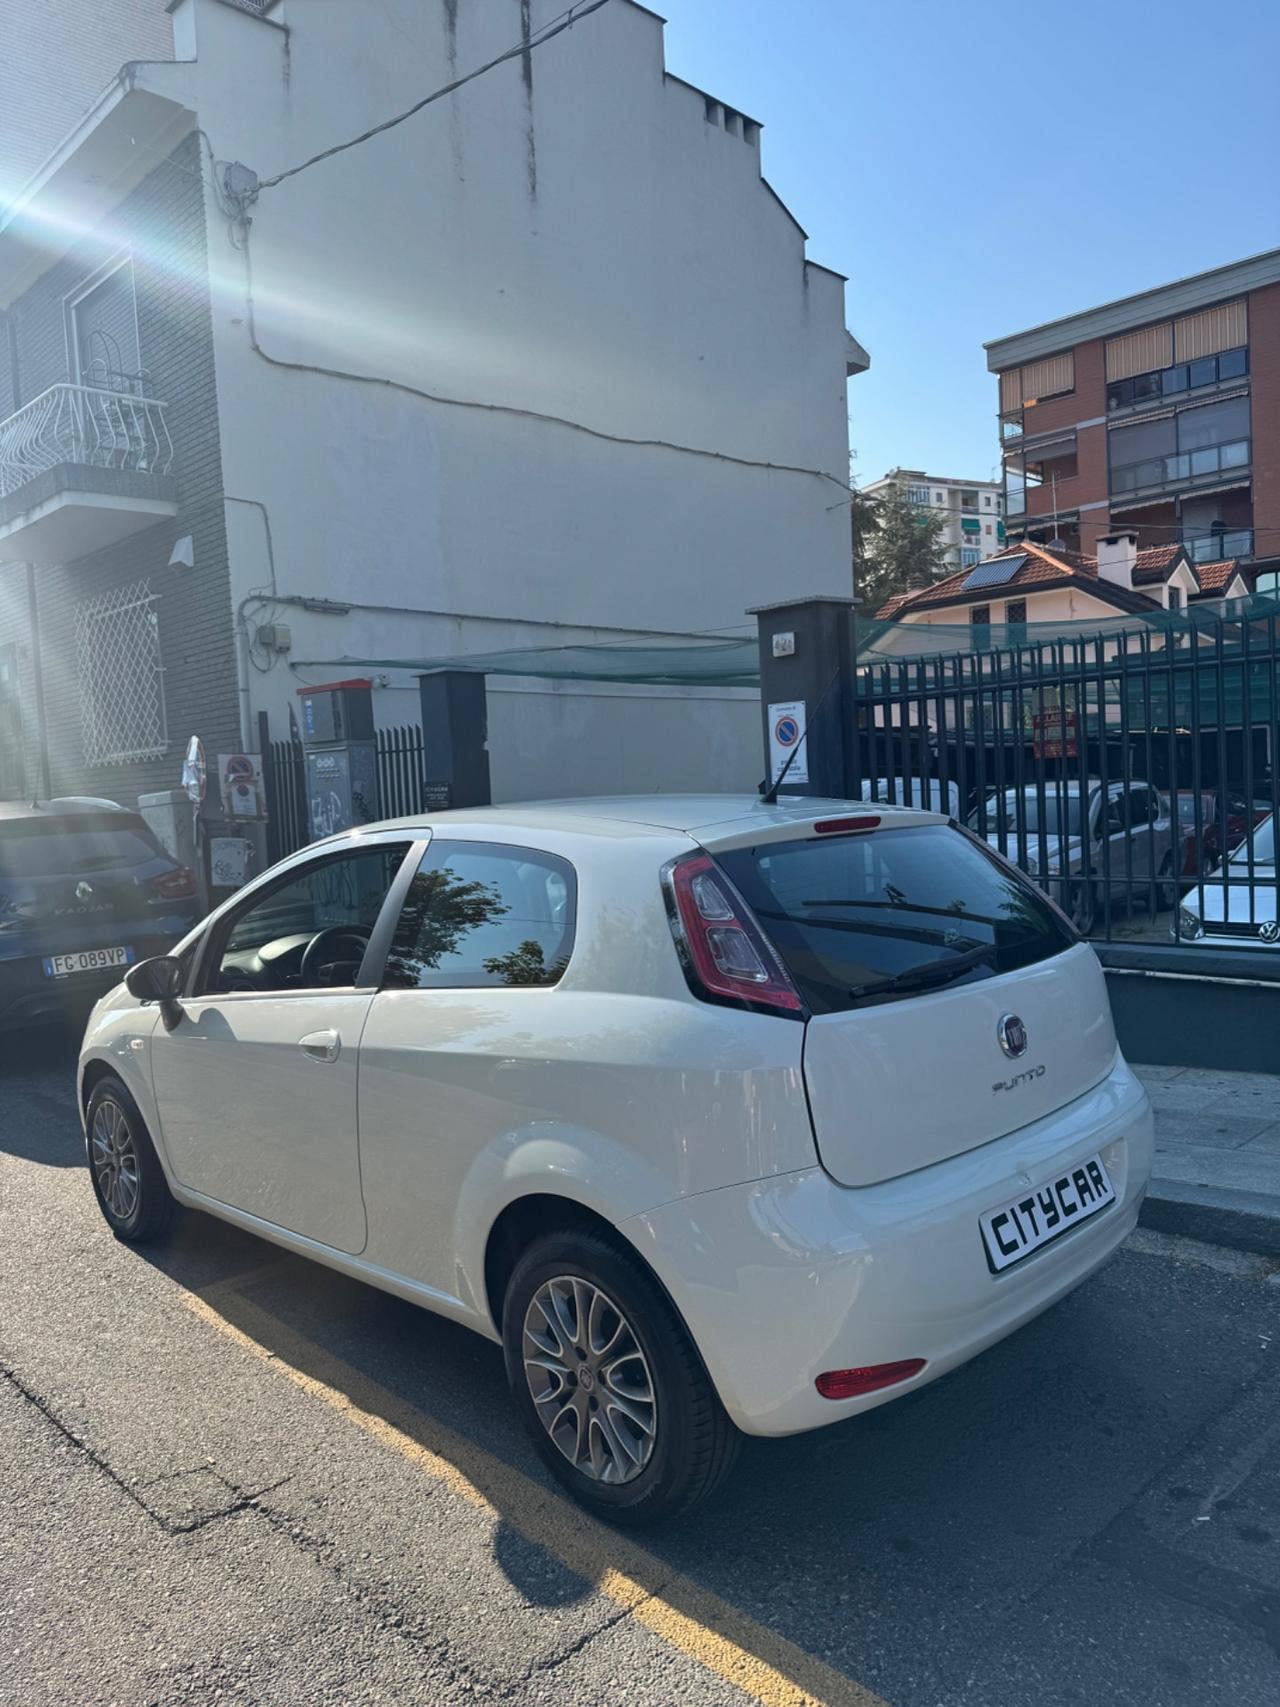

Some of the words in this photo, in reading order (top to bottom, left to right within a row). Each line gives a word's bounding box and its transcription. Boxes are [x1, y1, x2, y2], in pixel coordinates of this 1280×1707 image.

[54, 956, 74, 972] FG
[992, 1065, 1046, 1095] PUNTO
[991, 1160, 1108, 1256] CITYCAR
